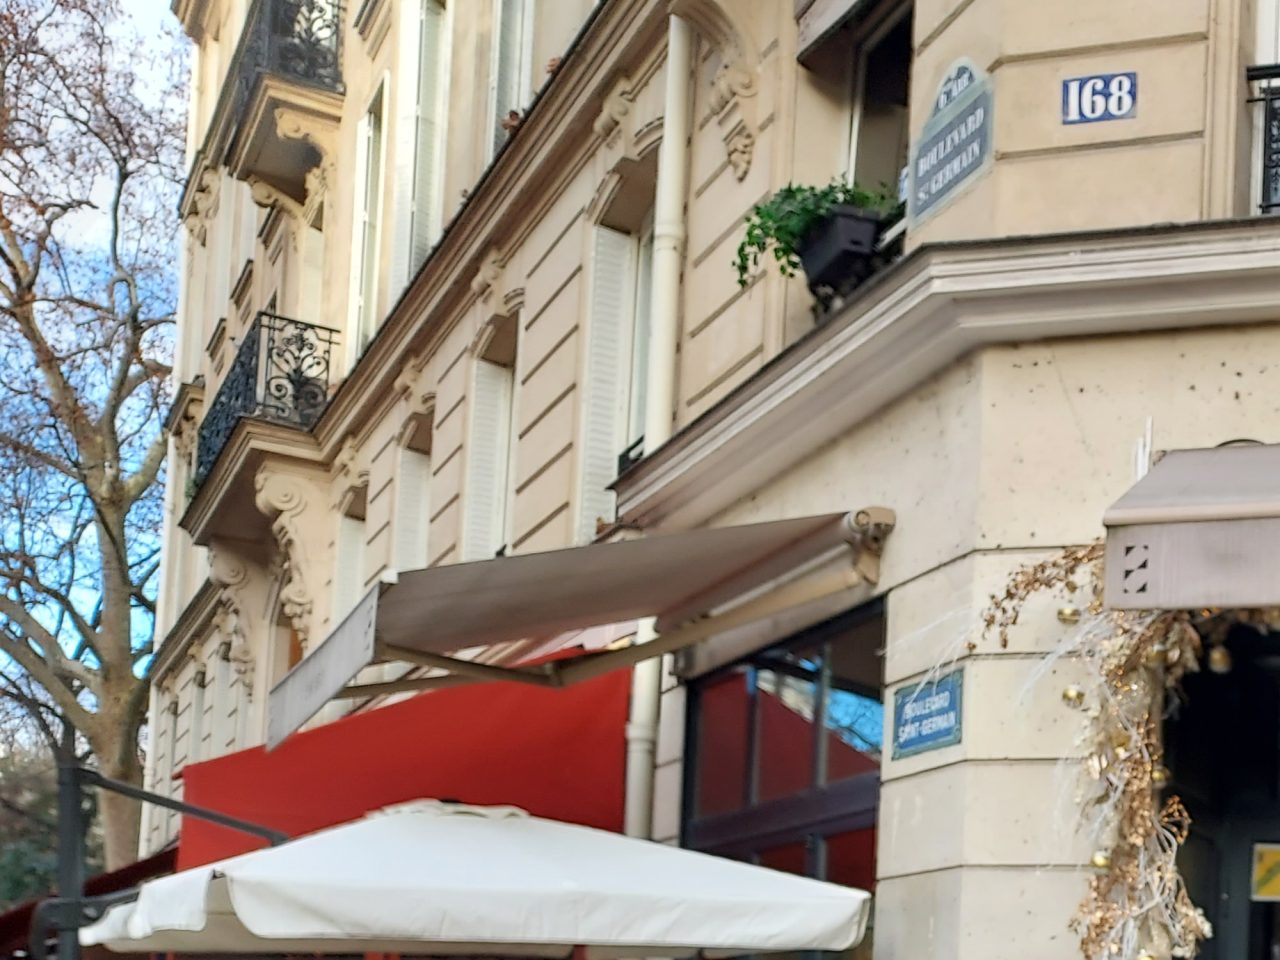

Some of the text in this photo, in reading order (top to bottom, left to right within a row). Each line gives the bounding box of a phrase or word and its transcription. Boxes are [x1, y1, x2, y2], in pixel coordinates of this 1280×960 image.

[1065, 74, 1132, 121] 168
[918, 107, 984, 177] BOULEVARD
[930, 138, 980, 194] GERMAIN
